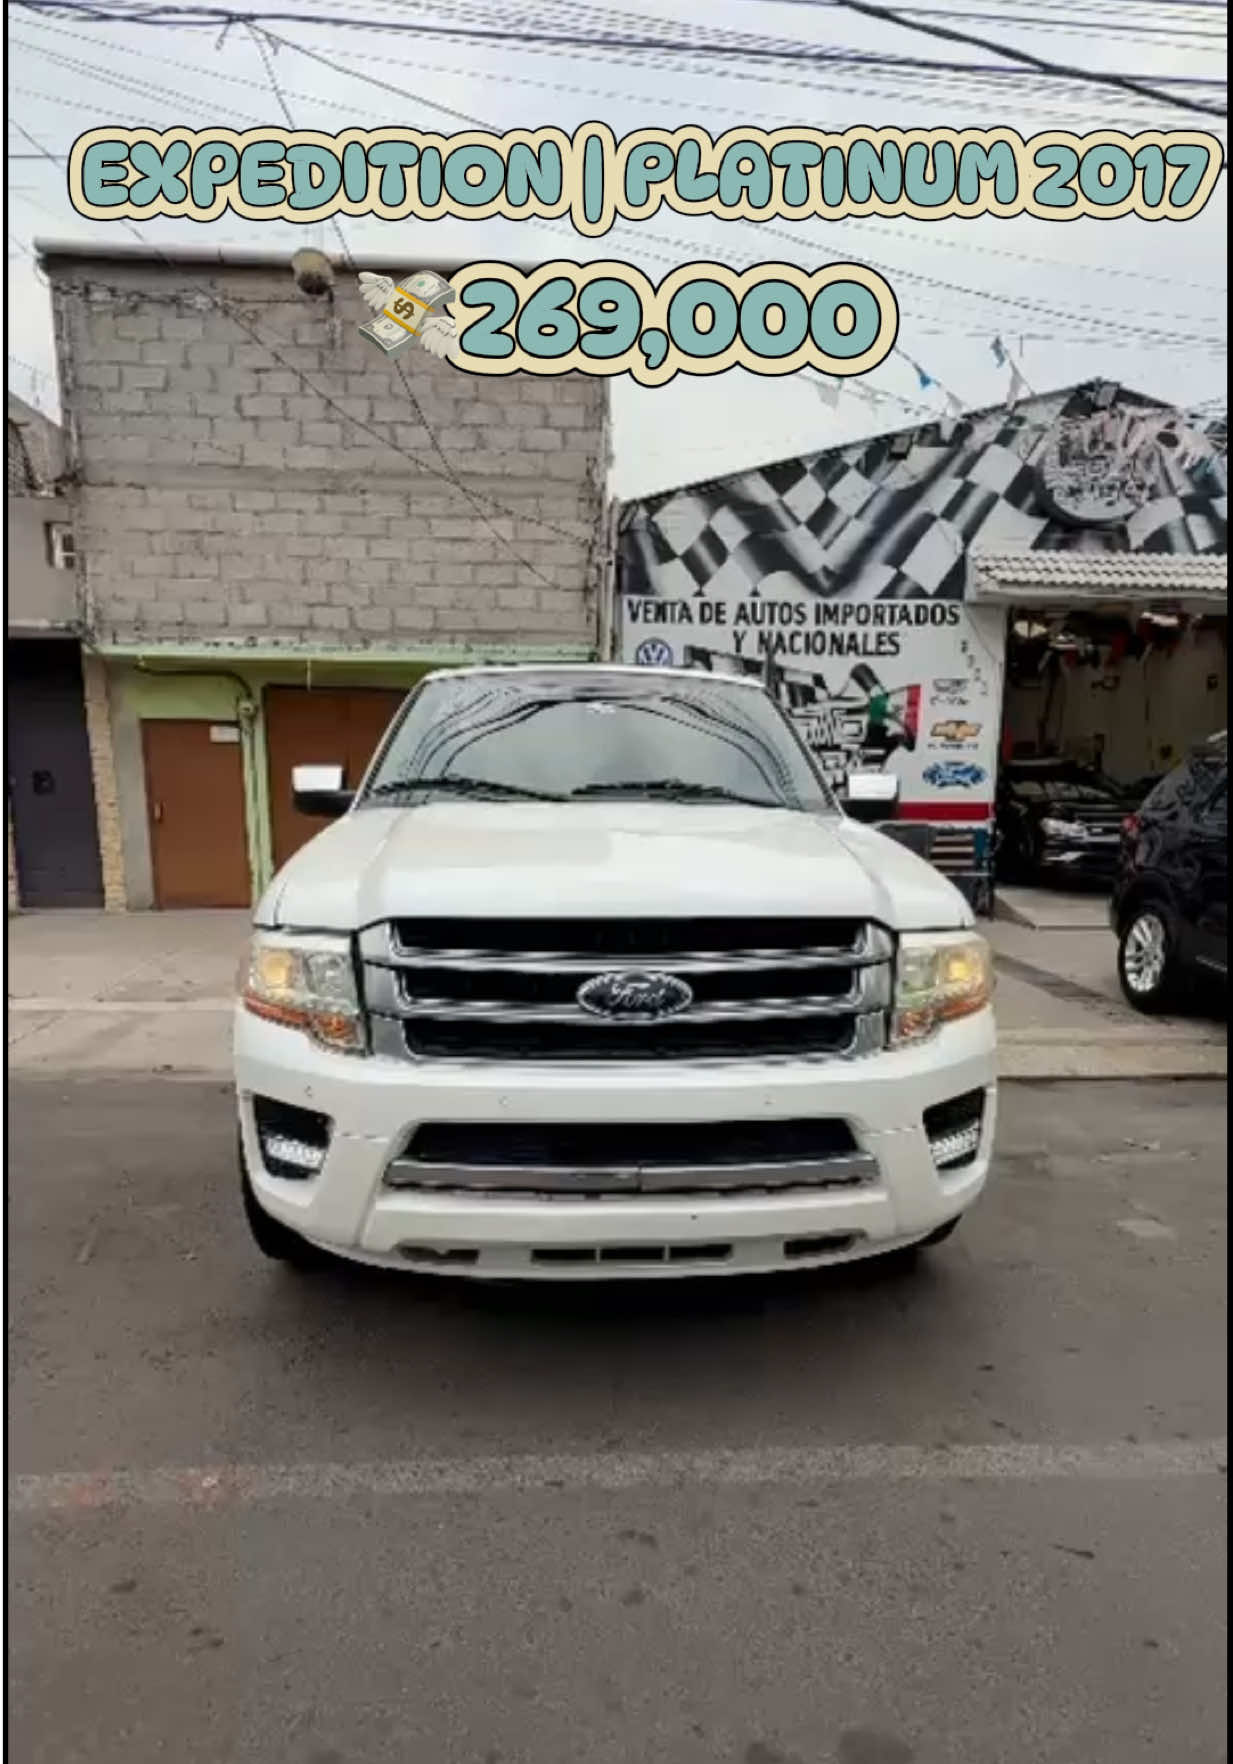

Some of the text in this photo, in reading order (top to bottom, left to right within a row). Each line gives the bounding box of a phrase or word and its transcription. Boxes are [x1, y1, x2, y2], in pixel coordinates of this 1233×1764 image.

[627, 600, 961, 627] VENTA DE AUTOS IMPORTADOS
[732, 629, 901, 656] Y NACIONALES
